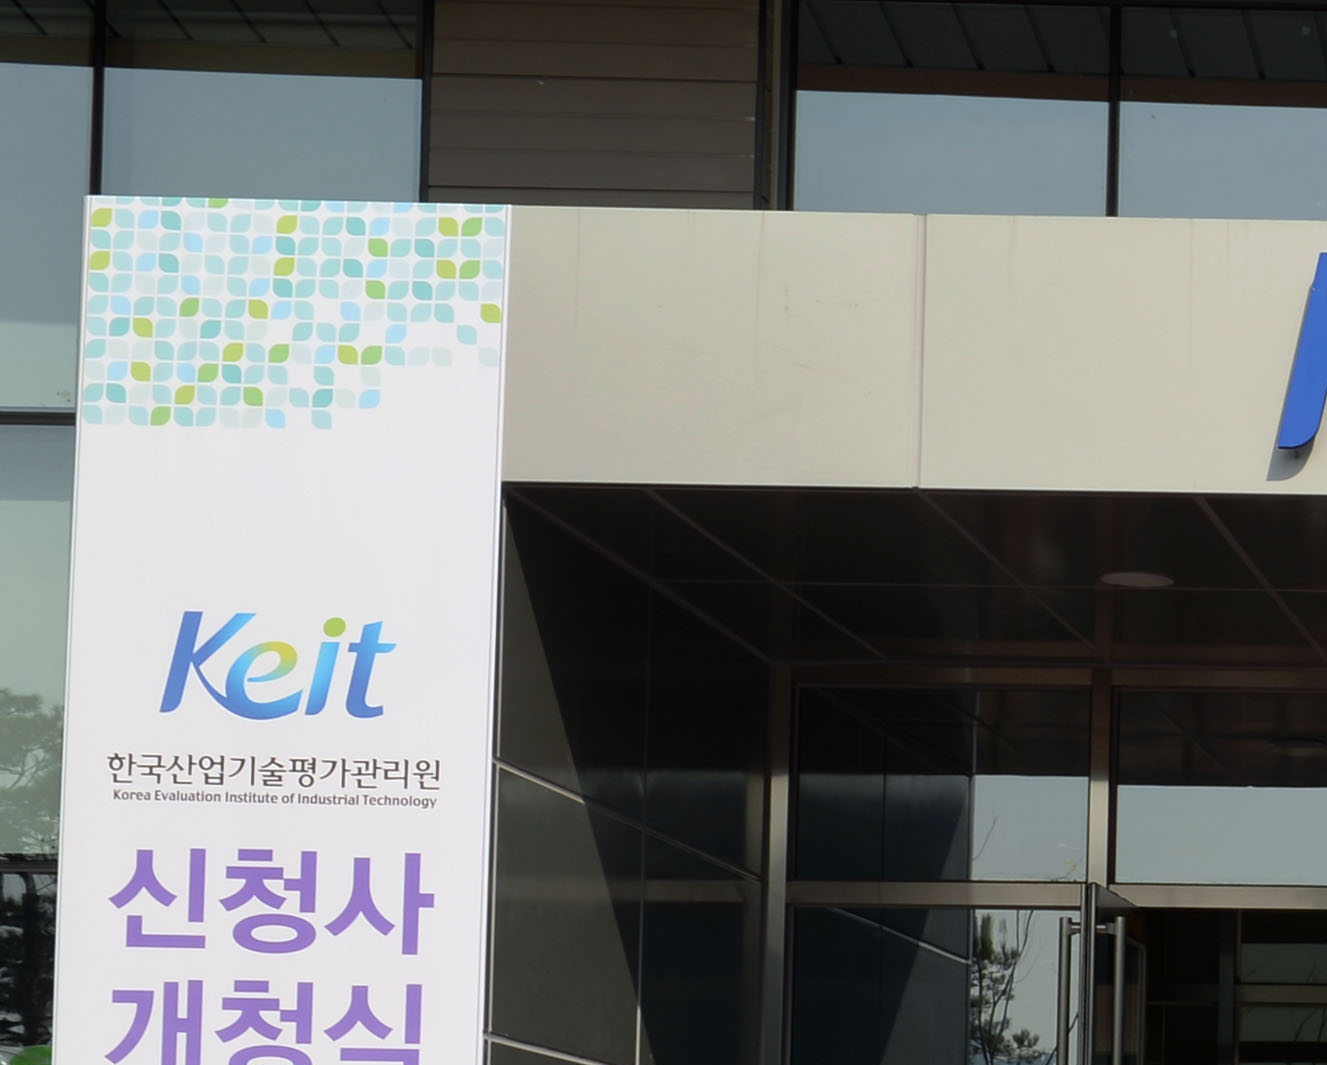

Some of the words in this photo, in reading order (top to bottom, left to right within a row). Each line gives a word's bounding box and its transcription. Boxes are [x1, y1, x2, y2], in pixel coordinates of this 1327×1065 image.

[159, 610, 397, 721] Keit
[107, 752, 441, 790] 한국산업기술평가관리원
[113, 788, 151, 801] Korea
[154, 789, 221, 803] Evaluation
[225, 791, 279, 804] Institute
[281, 793, 295, 804] of
[297, 793, 360, 806] Industrial
[362, 794, 438, 809] Technology
[108, 848, 435, 955] 신청사
